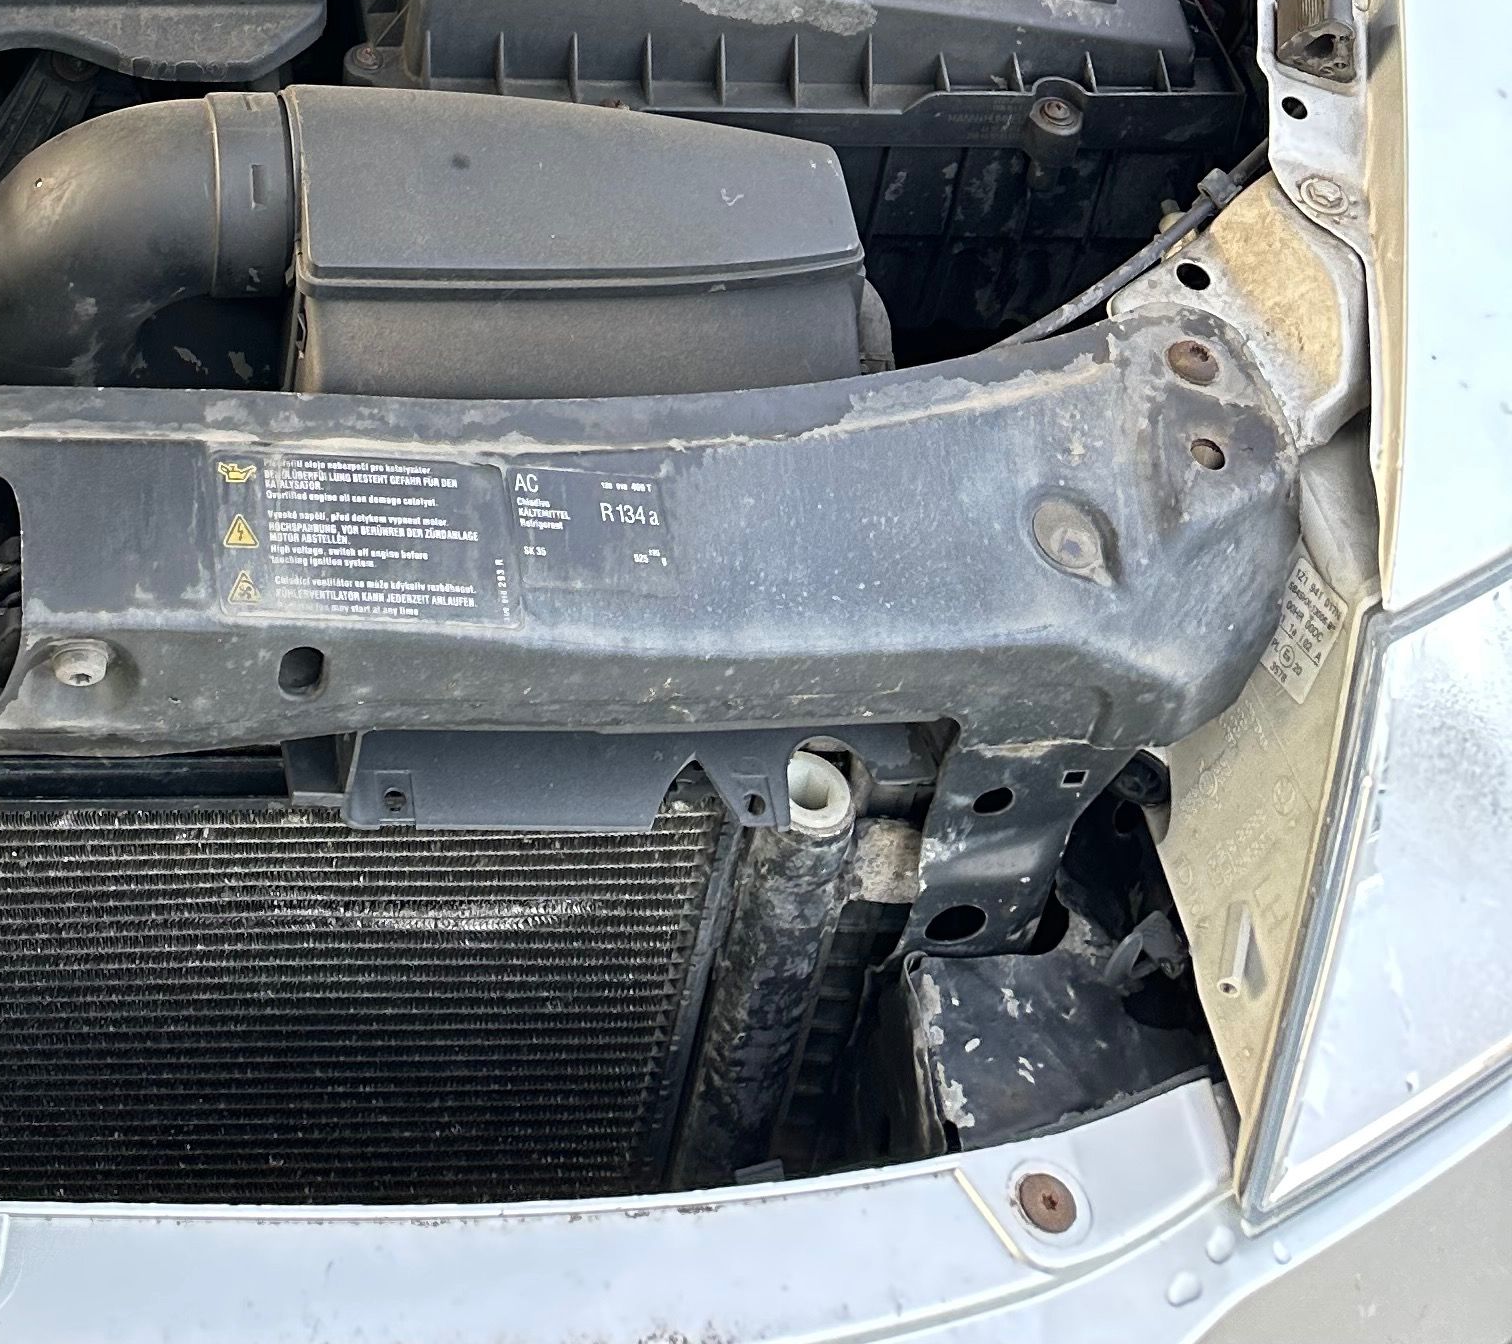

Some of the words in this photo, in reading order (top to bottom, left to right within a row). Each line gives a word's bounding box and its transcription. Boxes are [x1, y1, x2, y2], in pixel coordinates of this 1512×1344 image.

[389, 475, 422, 486] GEFAHR
[423, 476, 440, 487] FÜR
[441, 478, 458, 488] DEN
[514, 473, 539, 493] AC
[309, 493, 338, 502] engine
[368, 495, 402, 506] damage
[269, 532, 300, 543] MOTOR
[341, 524, 359, 534] VOR
[406, 527, 423, 538] DER
[270, 544, 290, 555] High
[328, 547, 355, 556] switch
[357, 547, 369, 556] off
[370, 549, 399, 559] engine
[523, 544, 535, 556] SK
[361, 591, 385, 603] KANN
[350, 604, 371, 613] start
